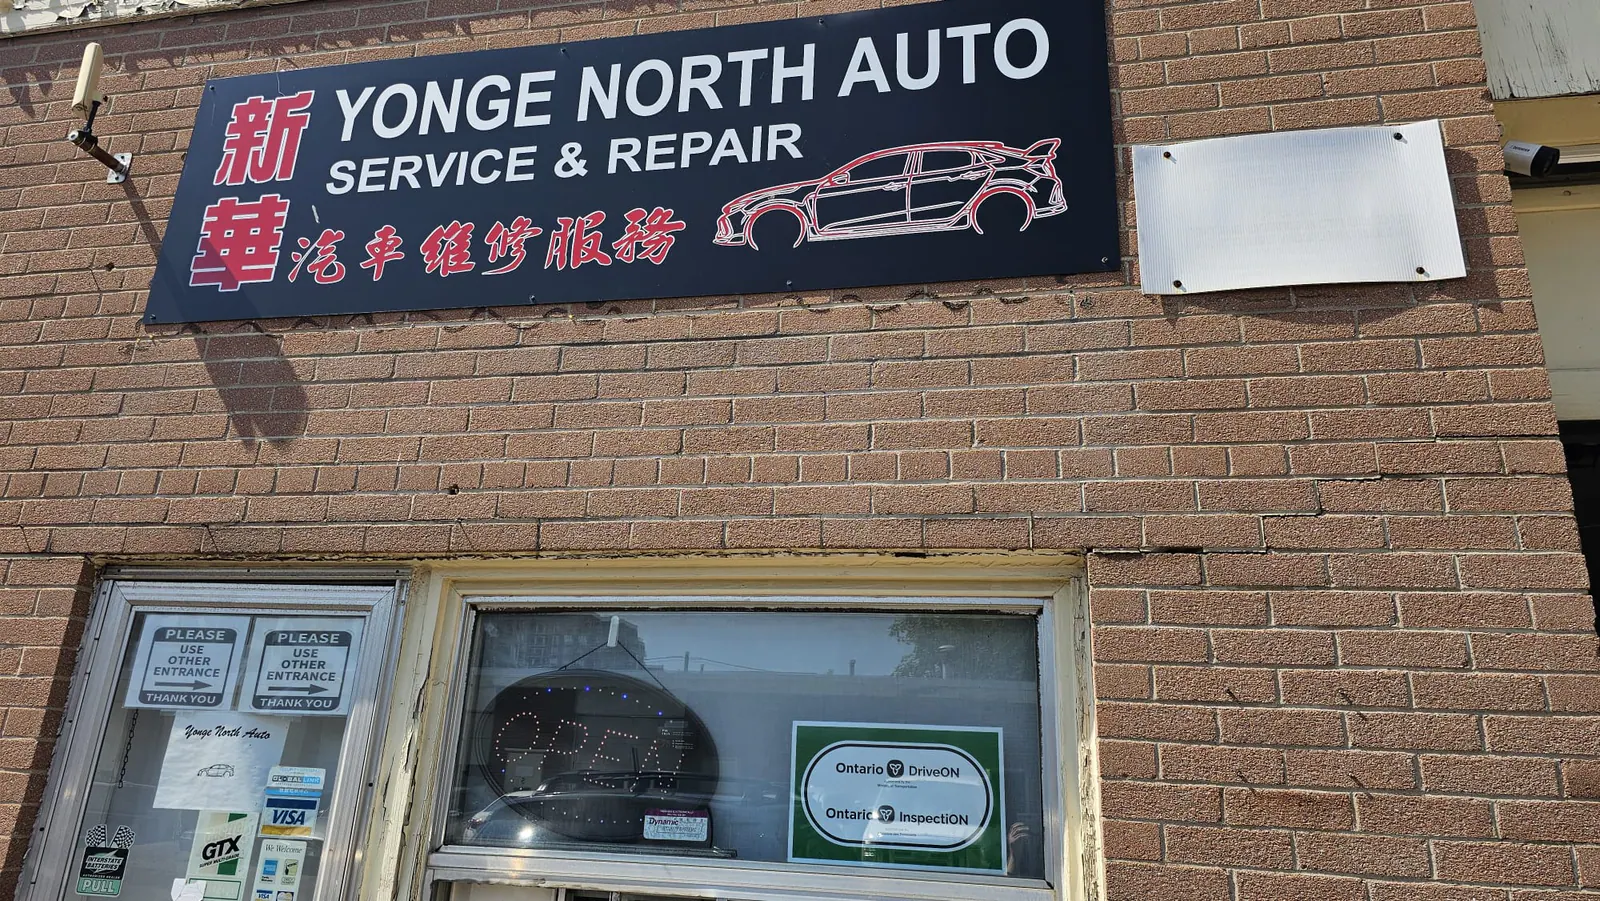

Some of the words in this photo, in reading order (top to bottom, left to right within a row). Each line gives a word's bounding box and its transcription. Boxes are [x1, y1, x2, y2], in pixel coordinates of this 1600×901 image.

[336, 70, 557, 142] YONGE
[576, 43, 815, 122] NORTH
[837, 17, 1050, 98] AUTO
[326, 145, 538, 196] SERVICE
[554, 142, 589, 179] &
[606, 123, 803, 175] REPAIR
[287, 206, 686, 285] 汽車維修服務
[165, 629, 226, 641] PLEASE
[277, 633, 340, 644] PLEASE
[179, 644, 205, 655] USE
[293, 648, 319, 658] USE
[168, 655, 211, 666] OTHER
[281, 659, 326, 670] OTHER
[153, 666, 220, 678] ENTRANCE
[266, 671, 336, 682] ENTRANCE
[146, 693, 188, 704] THANK
[190, 694, 217, 704] YOU
[260, 698, 302, 708] THANK
[305, 699, 332, 709] YOU
[185, 724, 212, 740] Yonge
[214, 725, 242, 737] North
[242, 727, 271, 739] Auto
[495, 712, 685, 800] OPEN
[836, 762, 884, 776] Ontario
[909, 765, 960, 778] DriveON
[272, 809, 306, 826] VISA
[649, 817, 679, 826] Dynamic
[899, 811, 969, 826] InspectiON
[202, 834, 242, 860] GTX
[265, 844, 274, 852] We
[276, 845, 302, 853] Welcome
[88, 856, 122, 864] INTERSTATE
[82, 879, 114, 893] PULL
